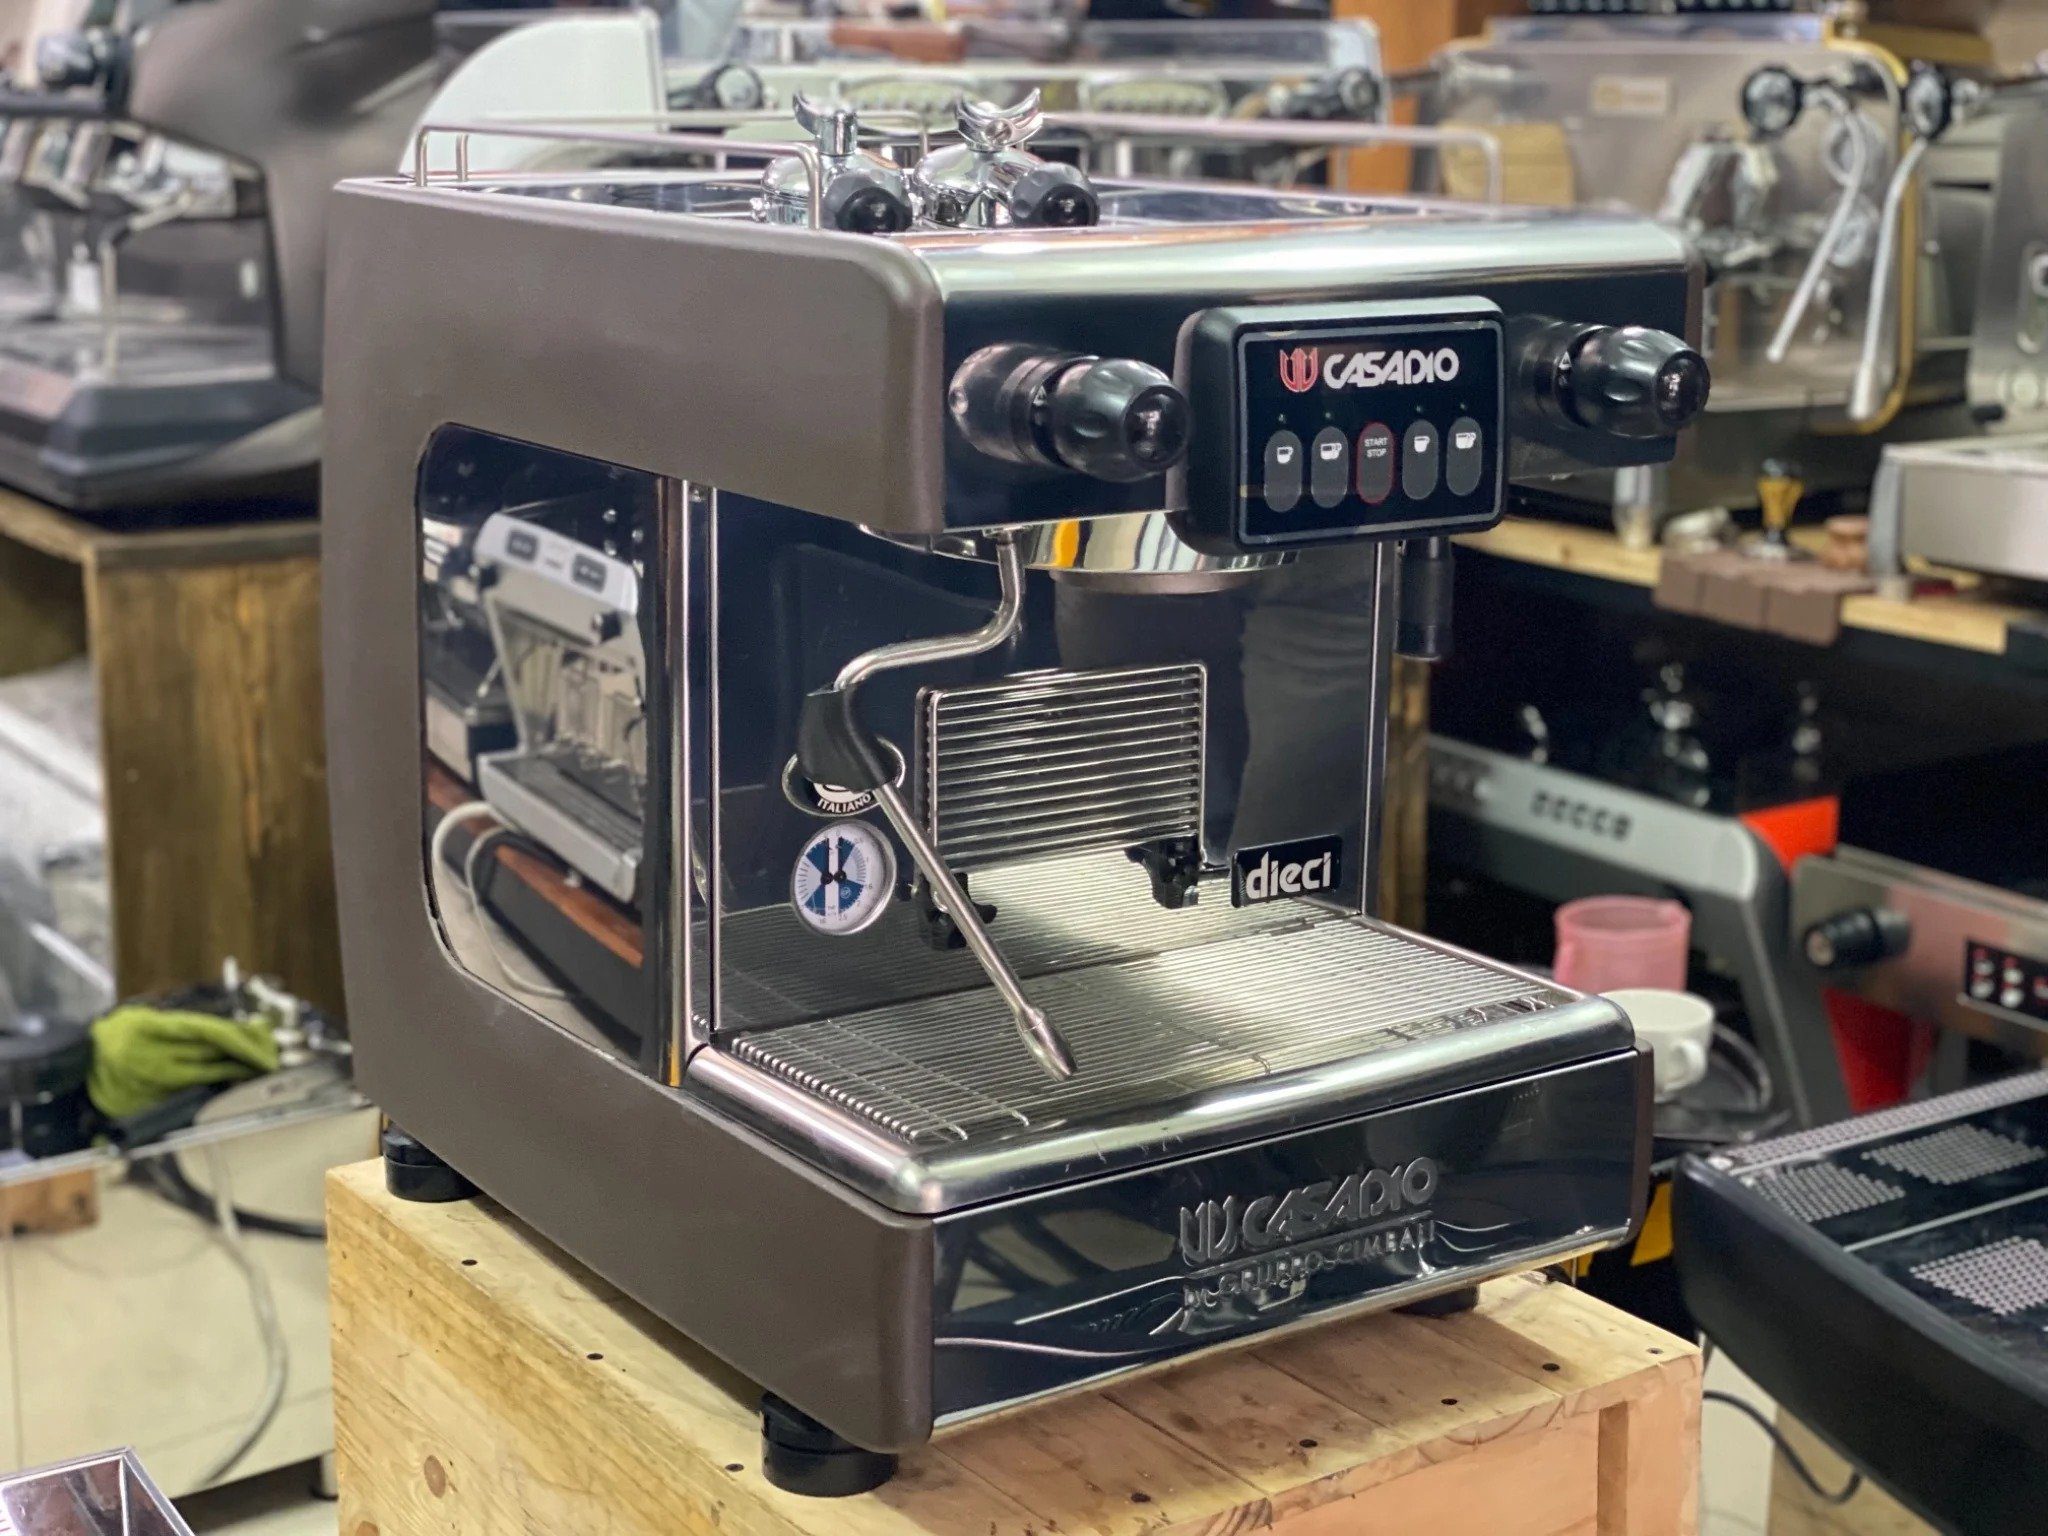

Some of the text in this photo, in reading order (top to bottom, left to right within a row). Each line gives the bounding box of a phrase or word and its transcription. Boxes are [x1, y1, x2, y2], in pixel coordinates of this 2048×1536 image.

[1322, 348, 1460, 389] CASADIO
[1364, 437, 1388, 447] START
[1366, 448, 1387, 458] STOP
[817, 793, 871, 813] ITALIANO
[1246, 851, 1332, 900] dieci
[1242, 1156, 1438, 1249] CASADIO
[1218, 1250, 1323, 1295] GRUPPO
[1335, 1218, 1436, 1260] CIMBALI
